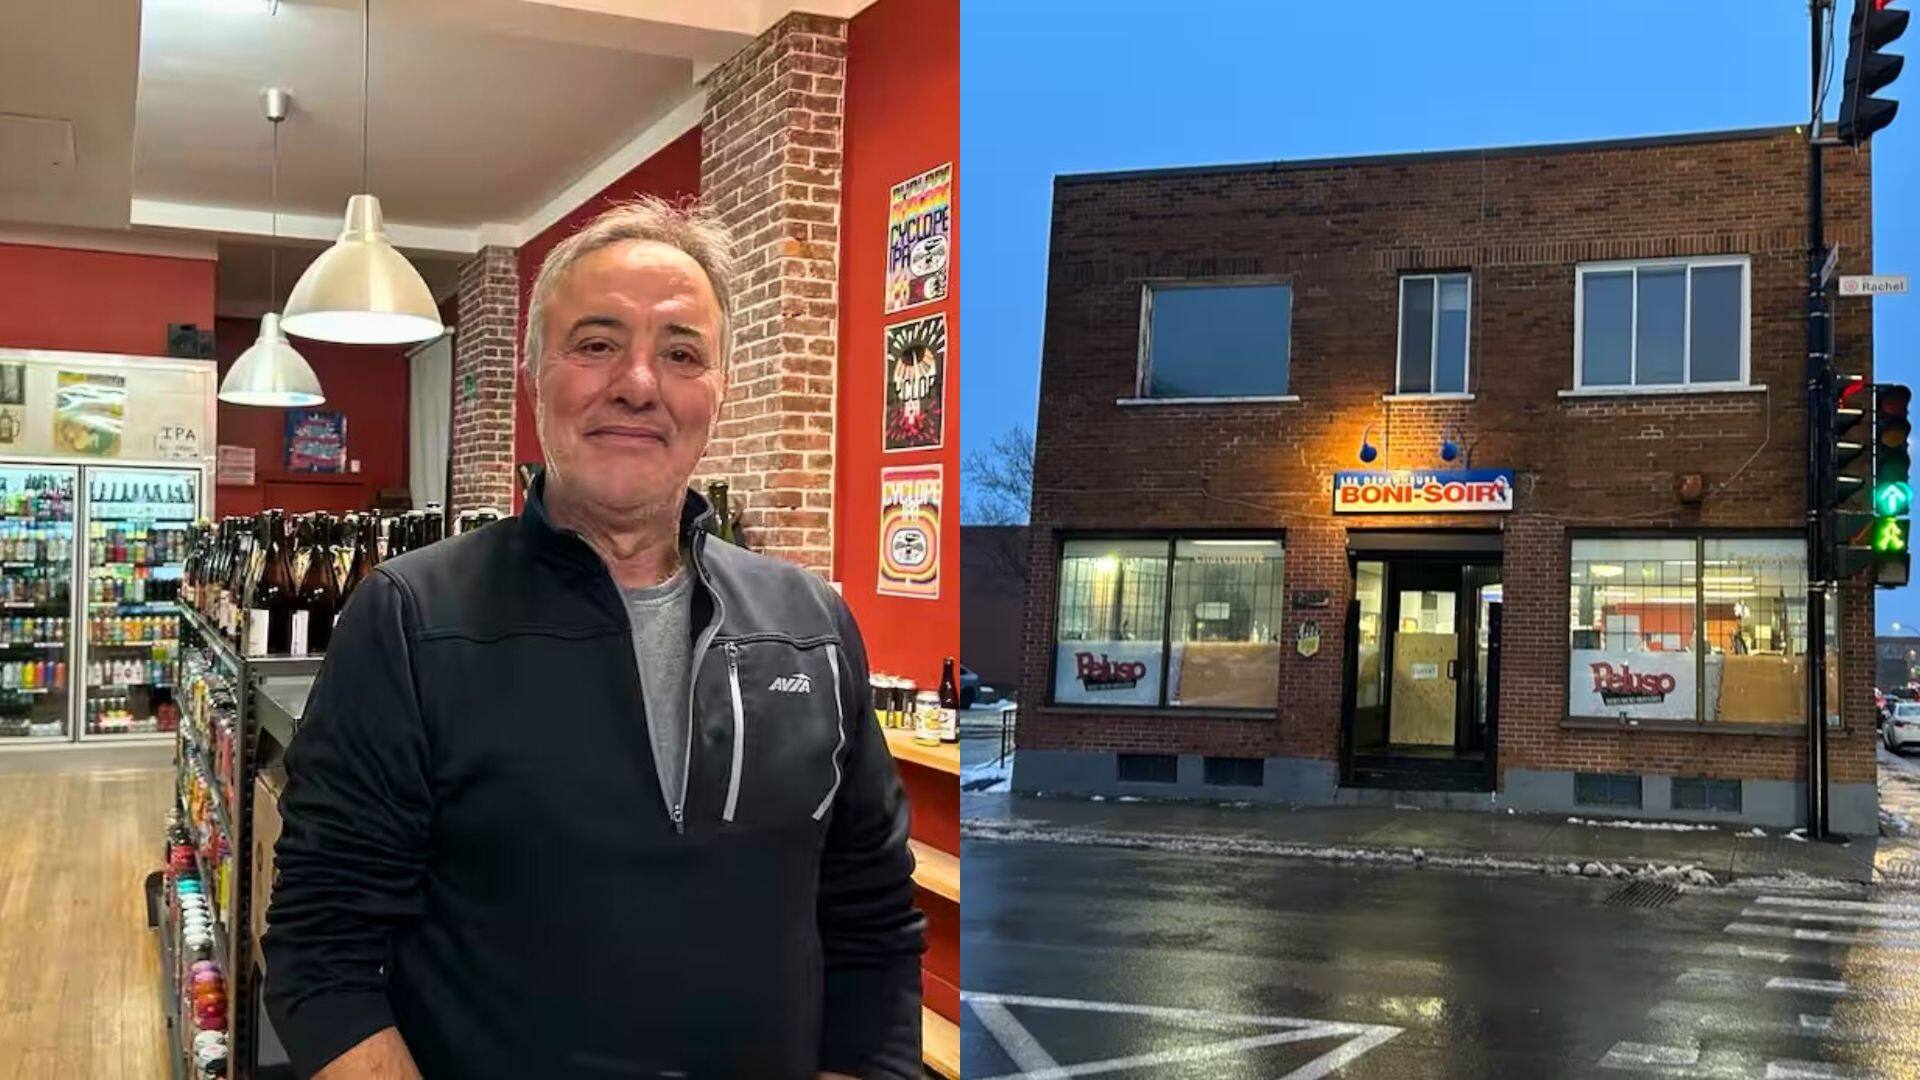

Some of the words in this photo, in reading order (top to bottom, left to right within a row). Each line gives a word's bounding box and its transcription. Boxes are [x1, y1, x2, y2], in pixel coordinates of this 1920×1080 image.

[891, 207, 949, 245] CYCLOPE
[889, 244, 912, 272] IPA
[1862, 281, 1904, 291] Rachel
[161, 427, 196, 440] IPA
[883, 480, 941, 505] CYCLOPE
[1341, 484, 1496, 504] BONI-SOIR
[1075, 652, 1147, 683] Peluso
[1590, 662, 1676, 697] Peluso
[768, 674, 811, 693] AVIA
